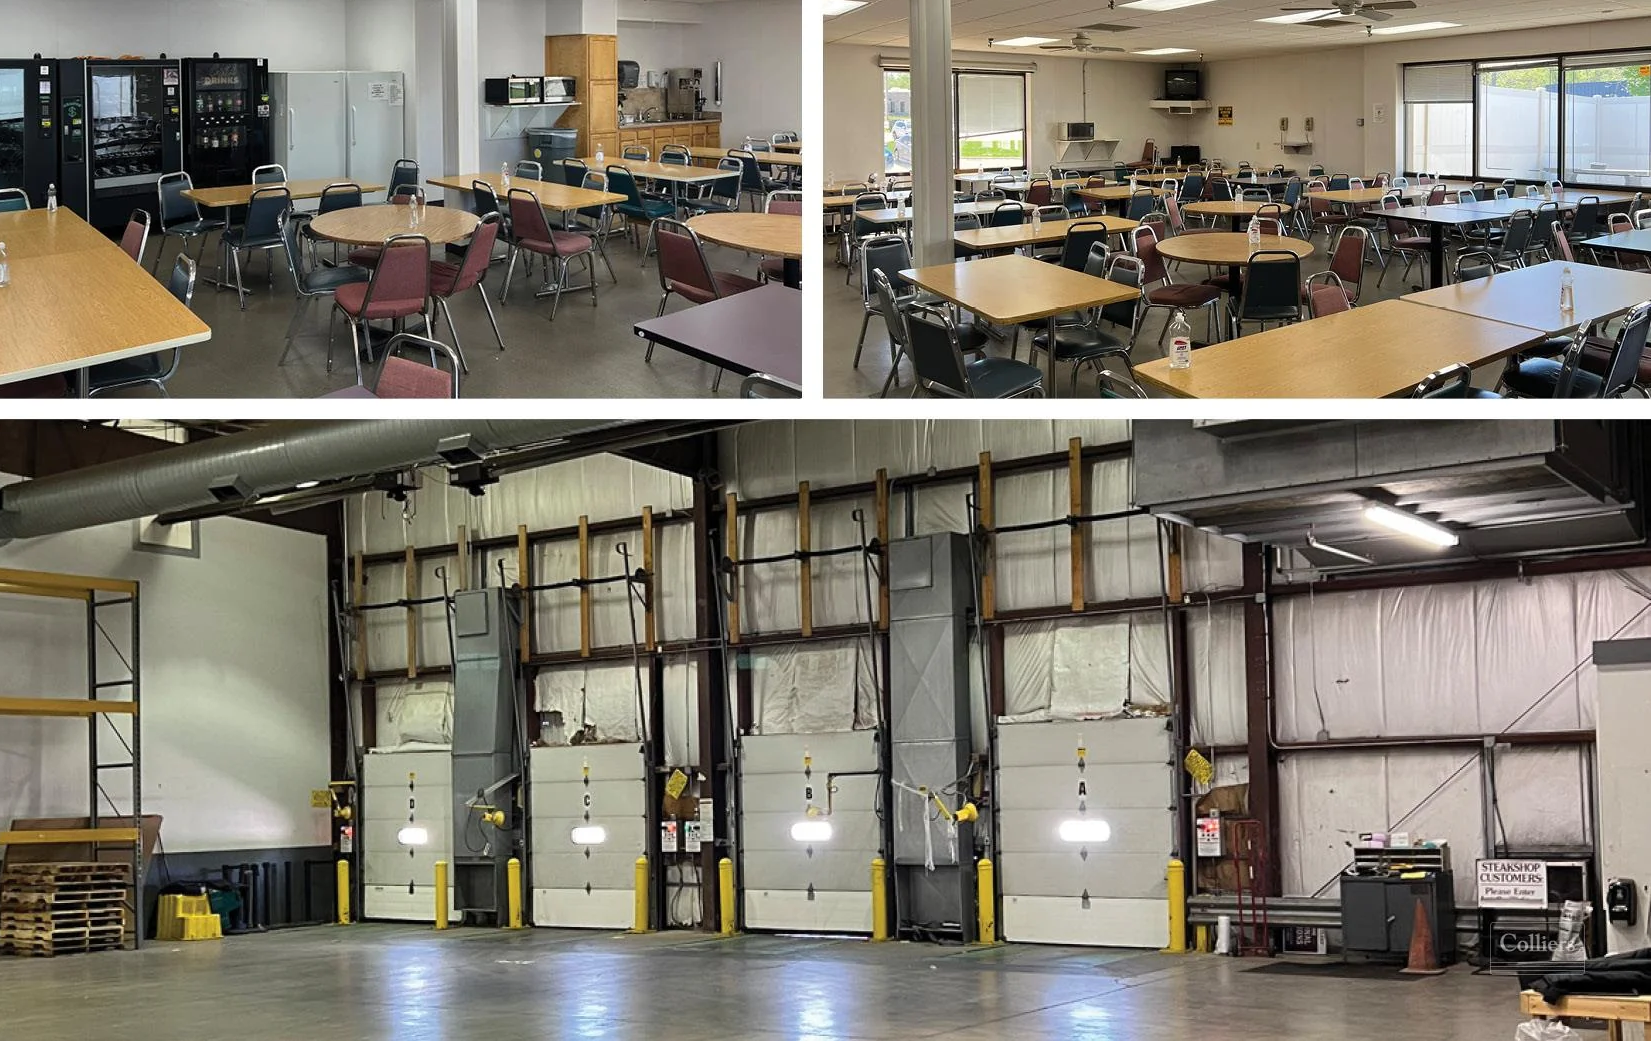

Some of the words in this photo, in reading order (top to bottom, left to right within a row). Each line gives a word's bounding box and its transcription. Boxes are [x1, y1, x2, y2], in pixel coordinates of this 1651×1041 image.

[203, 75, 239, 86] DRINKS
[805, 786, 813, 799] B
[1078, 781, 1086, 795] A
[583, 794, 591, 807] C
[1482, 862, 1541, 873] STEAKSHOP
[1484, 887, 1512, 896] Please
[1513, 887, 1536, 896] Enter
